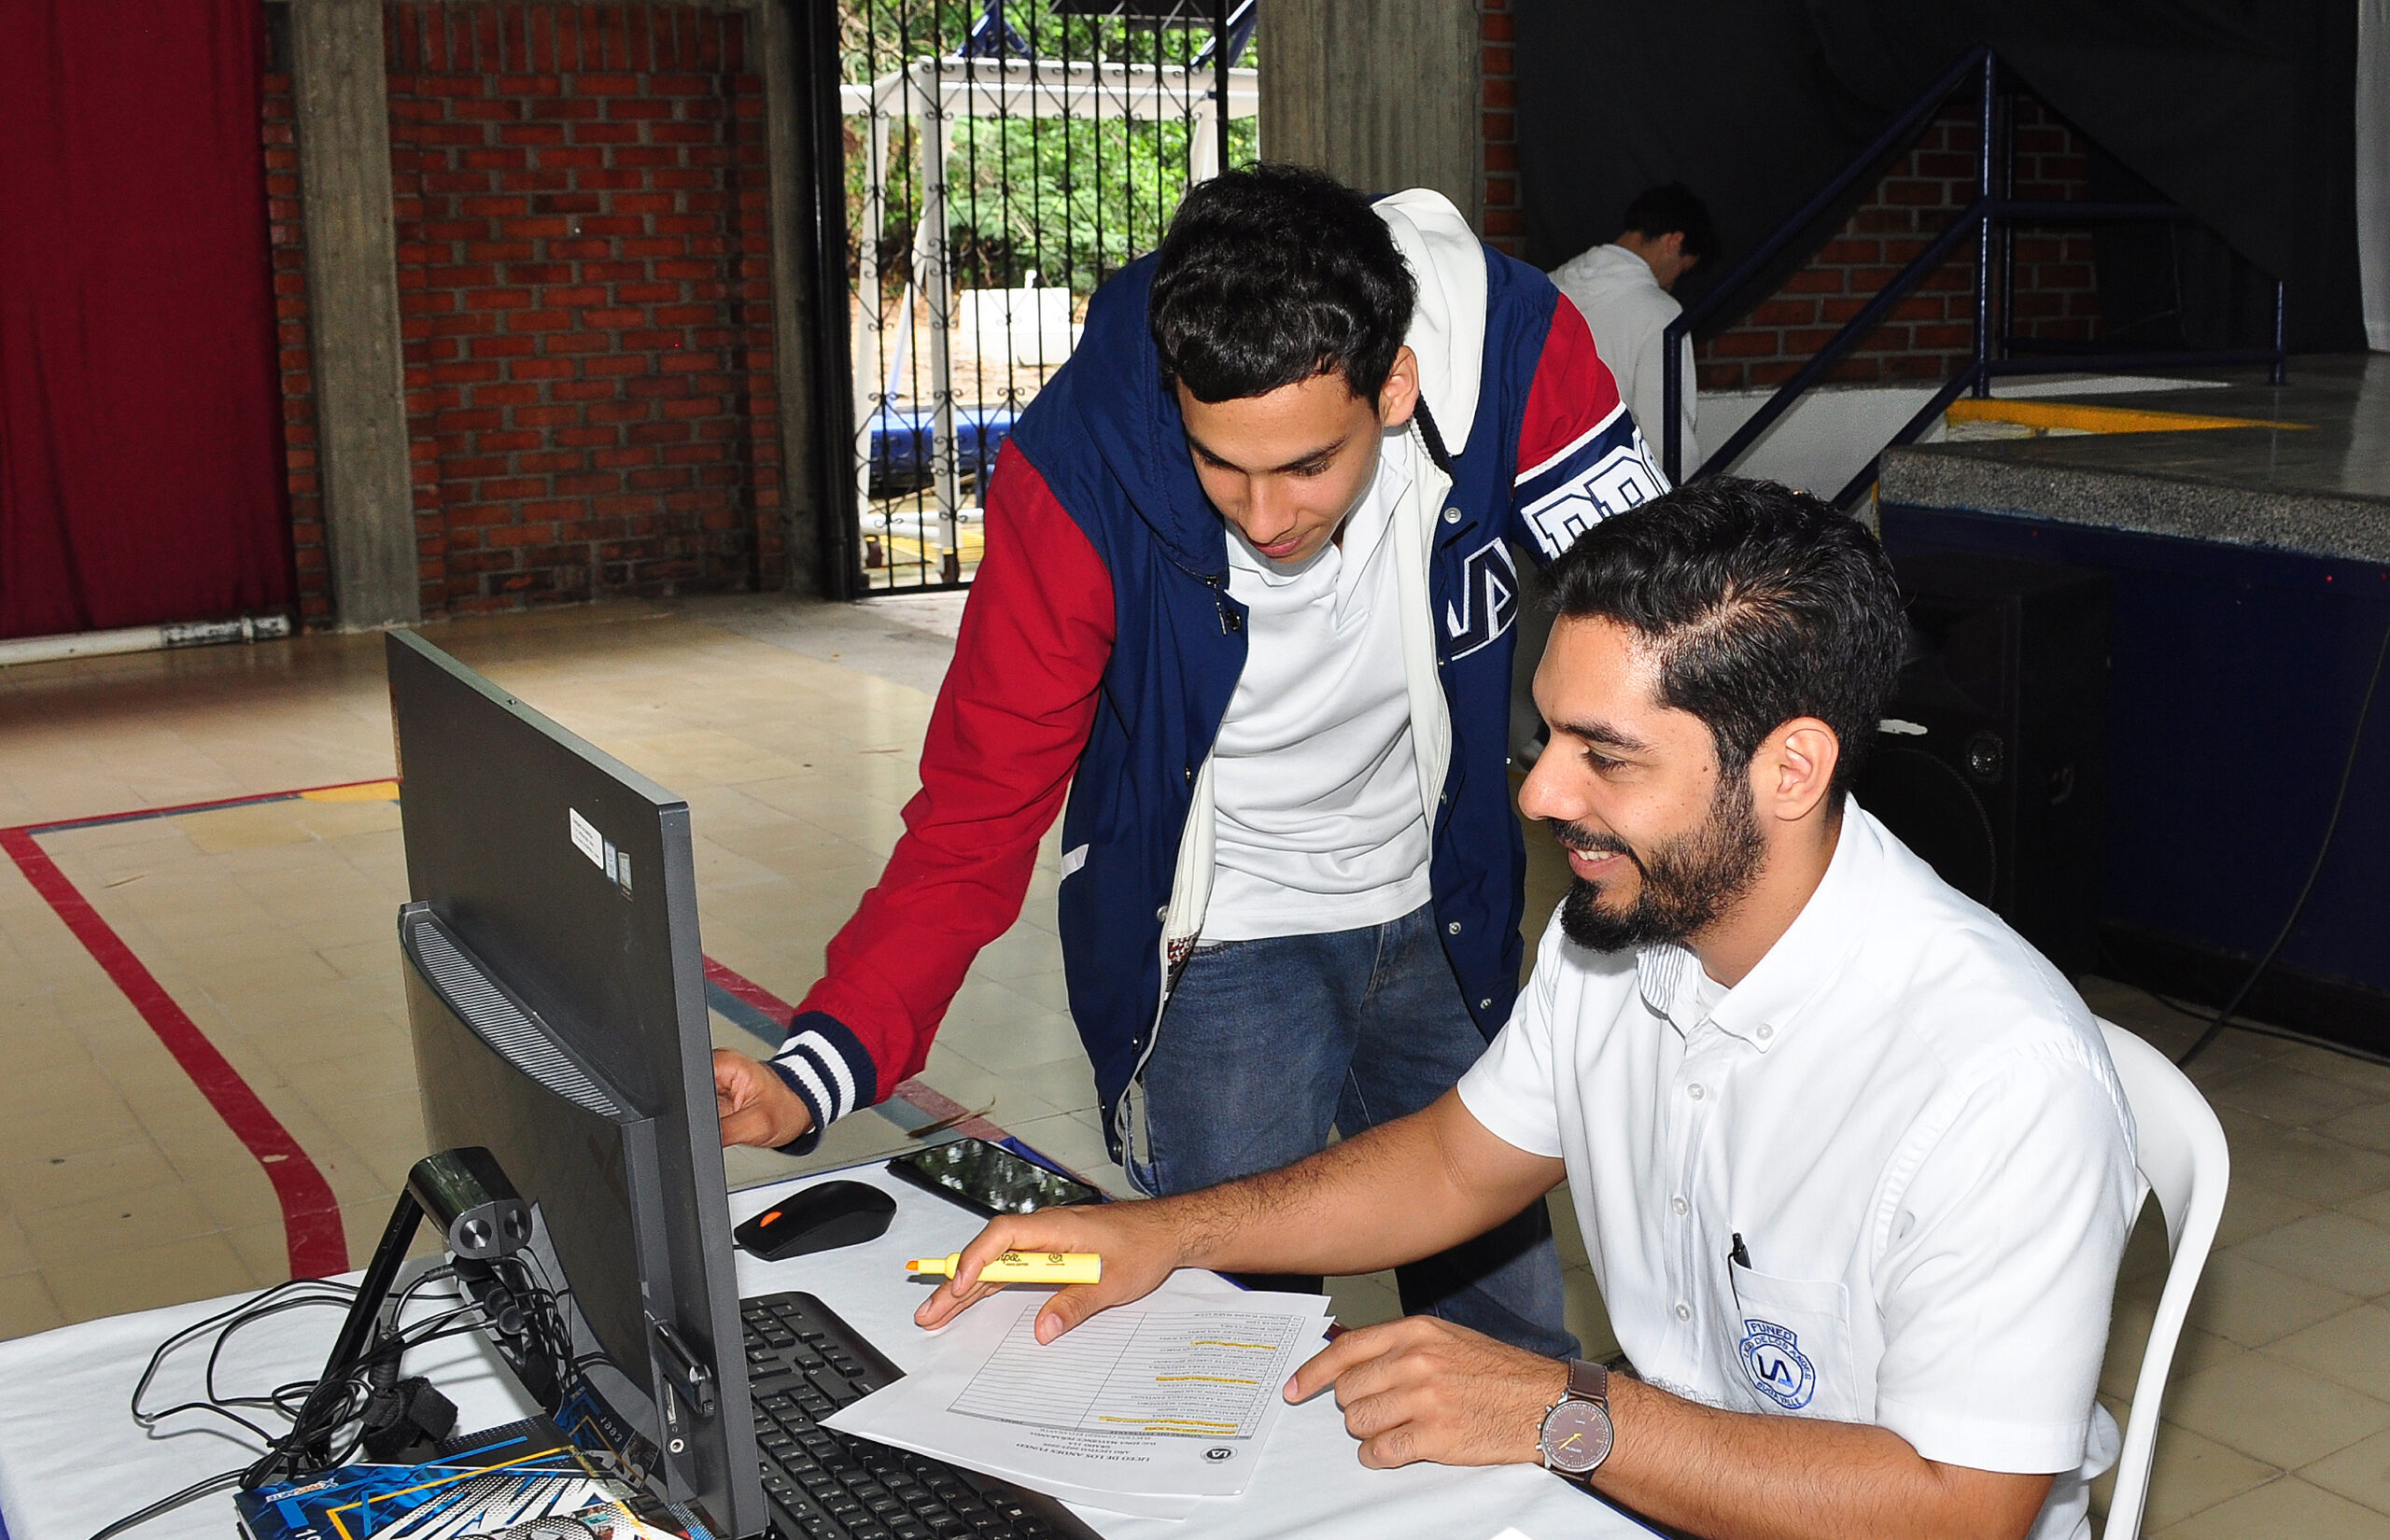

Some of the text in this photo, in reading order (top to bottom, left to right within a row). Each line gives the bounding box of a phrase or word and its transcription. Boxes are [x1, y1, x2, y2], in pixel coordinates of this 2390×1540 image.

[1750, 1323, 1792, 1341] FUNED
[1754, 1337, 1767, 1345] DE
[1789, 1350, 1812, 1380] ANDES
[1016, 1443, 1048, 1453] FUNED
[1049, 1449, 1084, 1457] ANDES
